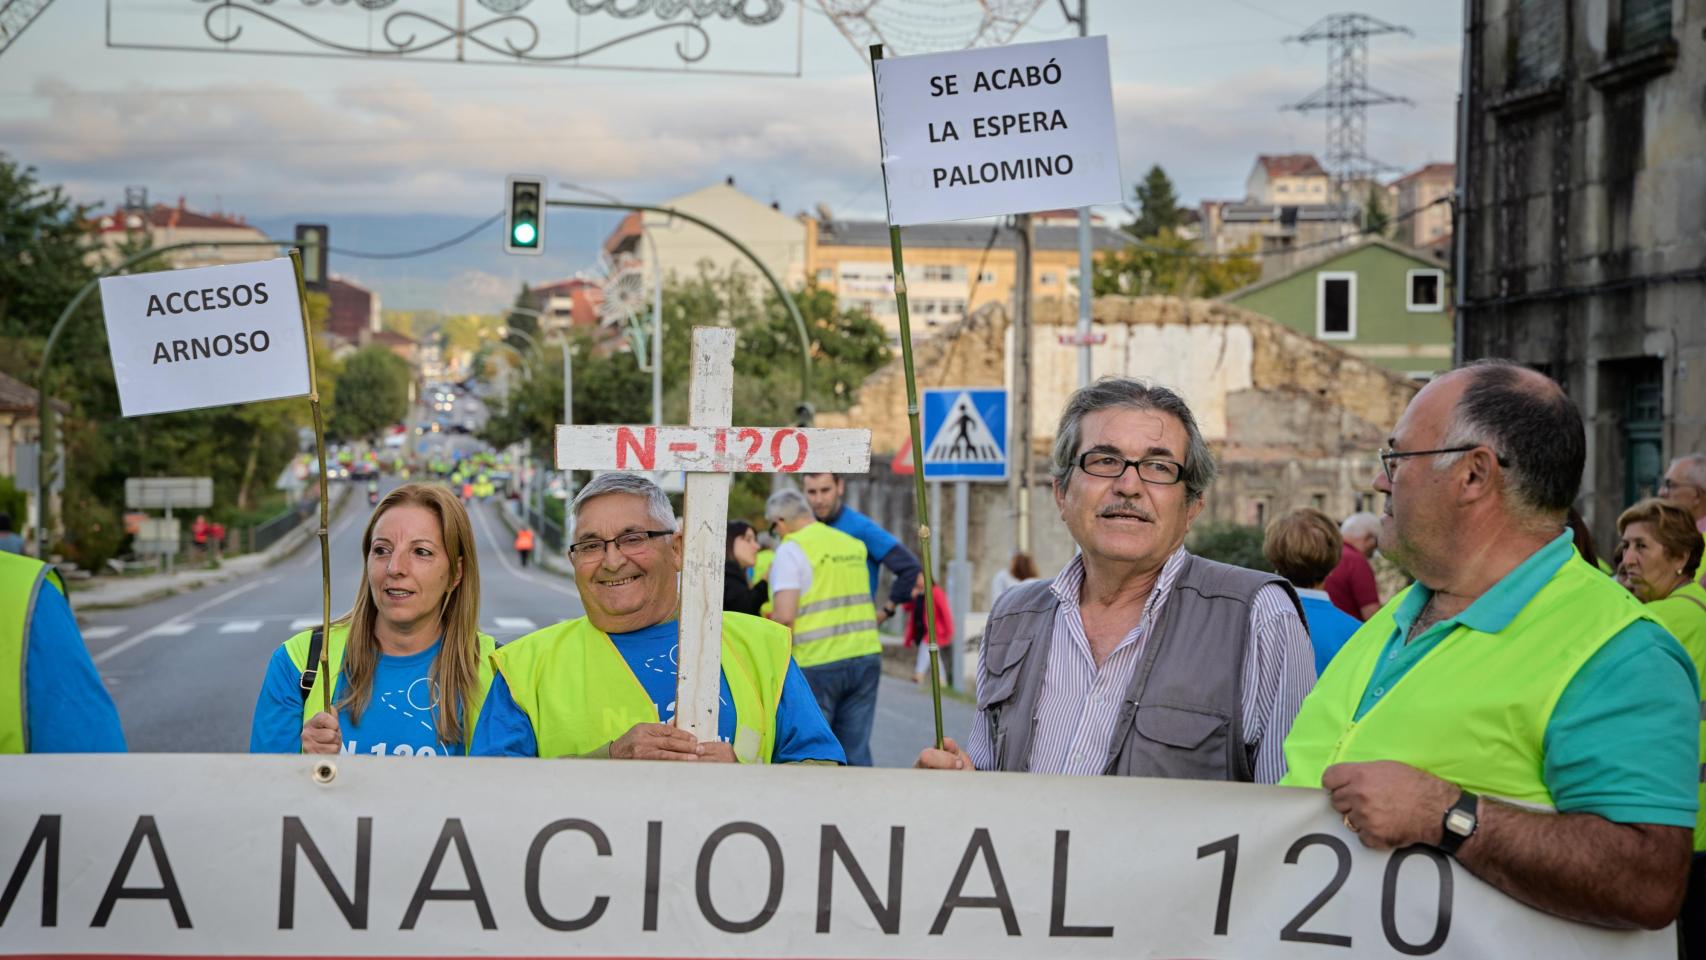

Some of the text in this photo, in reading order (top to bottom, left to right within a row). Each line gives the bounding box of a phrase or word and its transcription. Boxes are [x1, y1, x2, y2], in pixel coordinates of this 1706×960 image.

[929, 57, 1062, 97] SE ACABÓ
[928, 109, 1068, 143] LA ESPERA
[932, 154, 1074, 188] PALOMINO
[146, 282, 269, 317] ACCESOS
[152, 330, 270, 364] ARNOSO
[277, 815, 1115, 938] NACIONAL
[1196, 832, 1455, 956] 120
